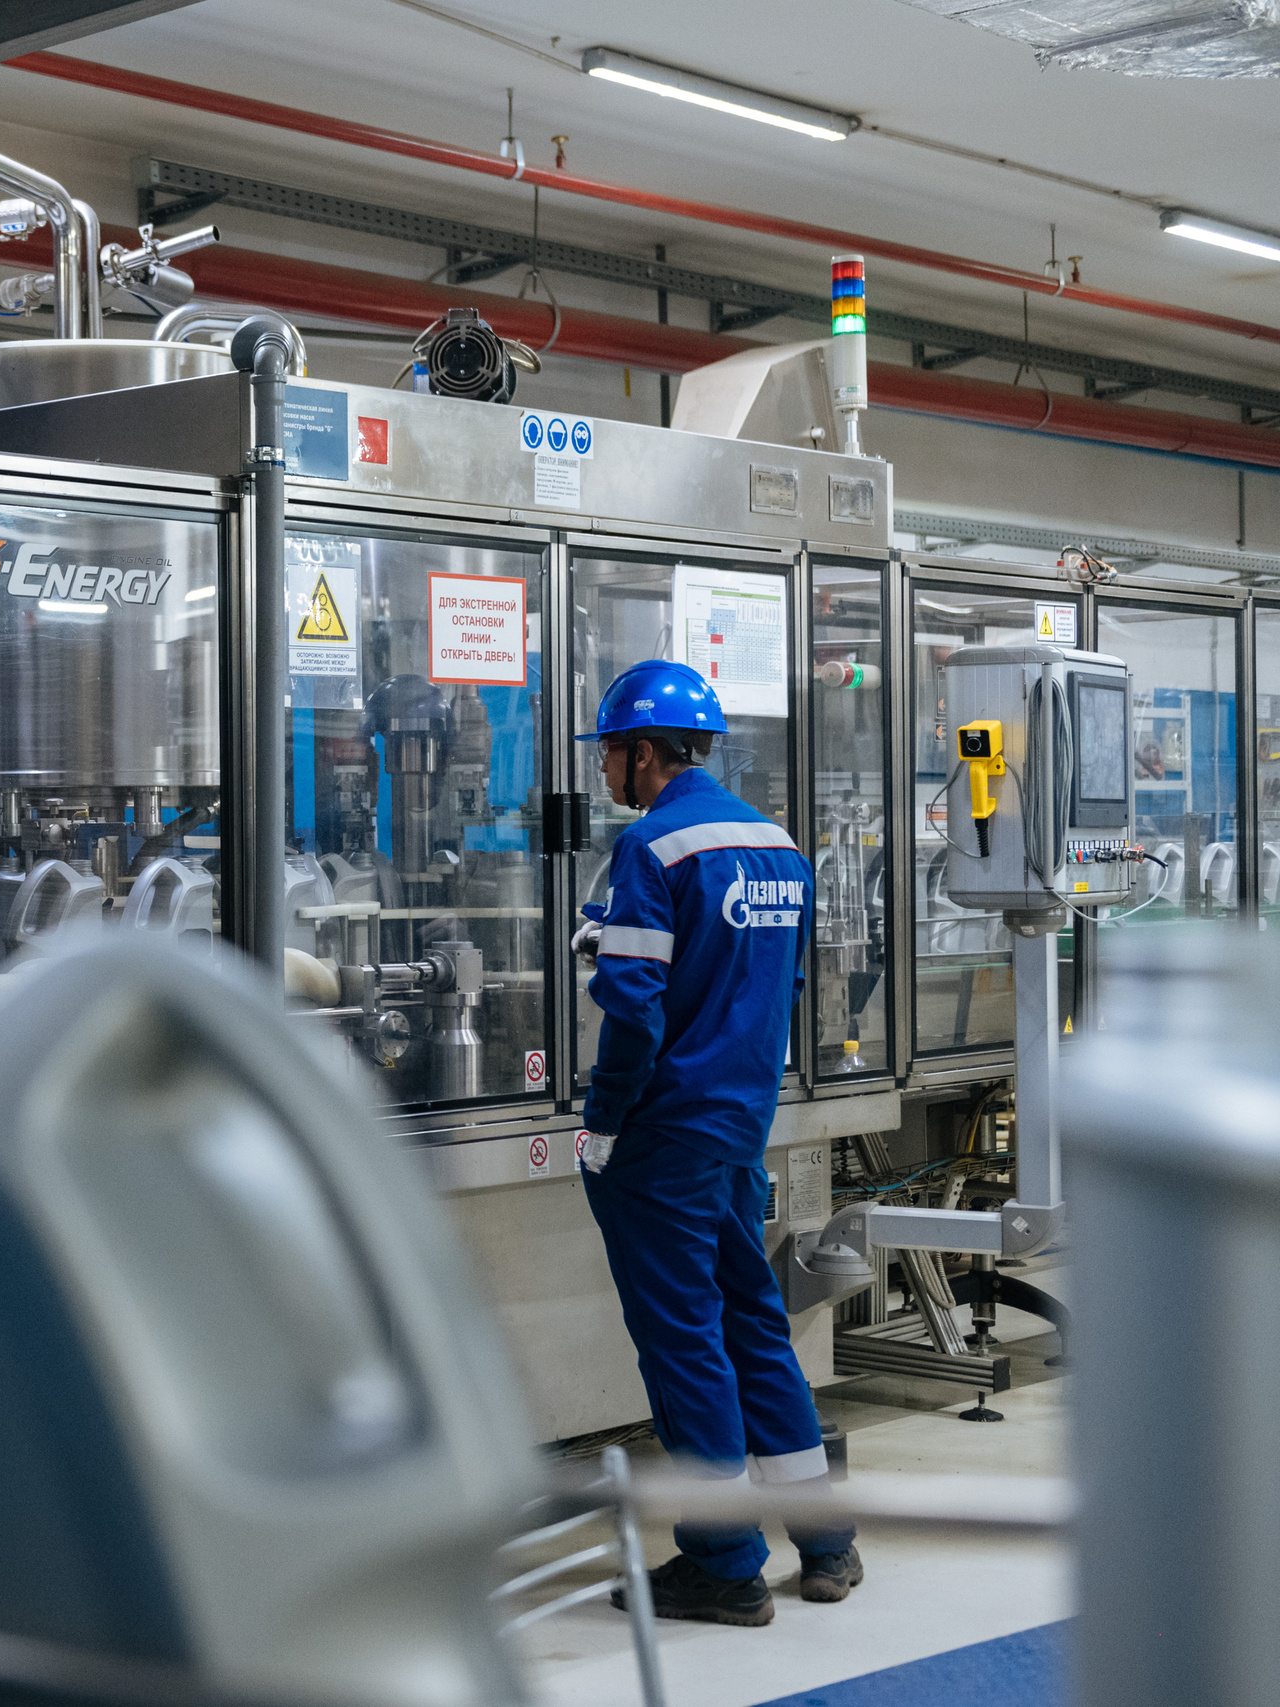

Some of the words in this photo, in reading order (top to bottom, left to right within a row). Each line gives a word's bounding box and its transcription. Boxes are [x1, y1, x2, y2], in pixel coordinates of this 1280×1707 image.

[284, 403, 318, 412] томатическая
[111, 555, 151, 565] ENGINE
[156, 558, 173, 567] OIL
[439, 597, 457, 609] ДЛЯ
[460, 598, 516, 612] ЭКСТРЕННОЙ
[452, 615, 504, 628] ОСТАНОВКИ
[461, 632, 491, 644] ЛИНИИ
[441, 648, 482, 660] ОТКРЫТЬ
[484, 651, 516, 662] ДВЕРЬ!
